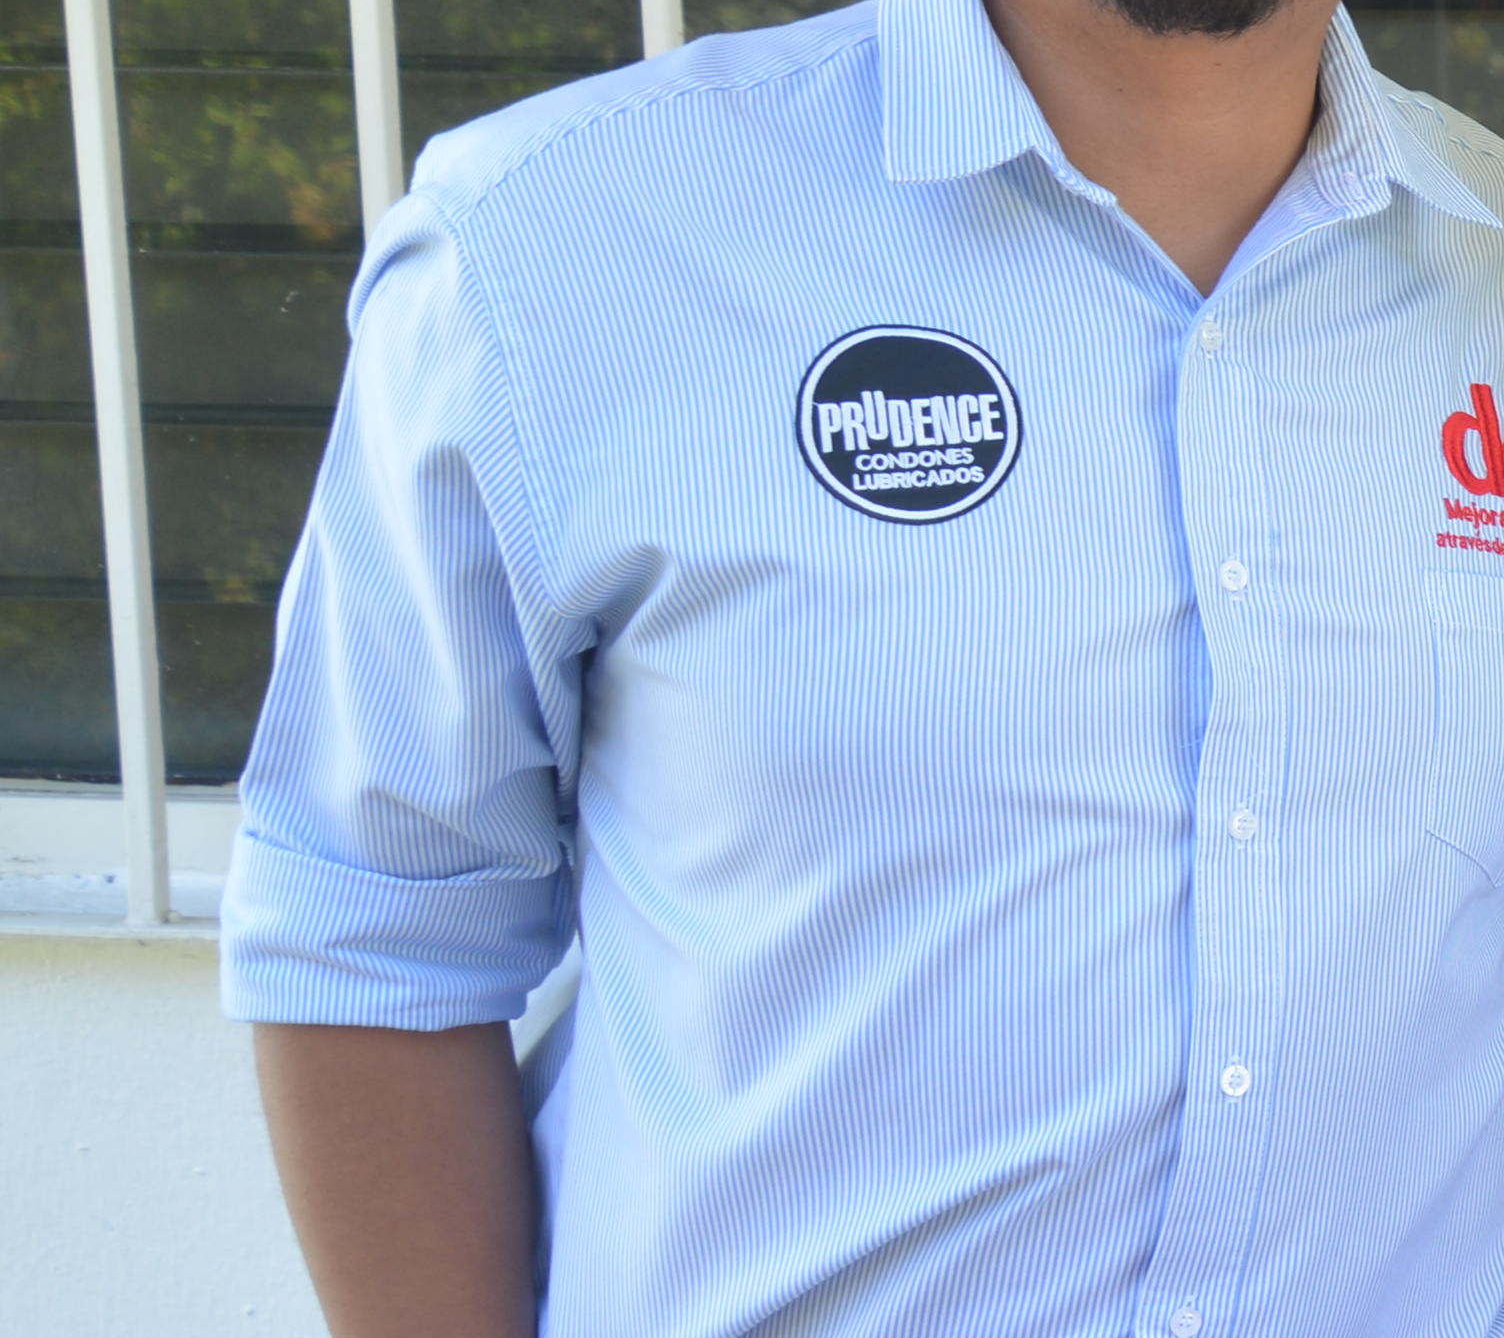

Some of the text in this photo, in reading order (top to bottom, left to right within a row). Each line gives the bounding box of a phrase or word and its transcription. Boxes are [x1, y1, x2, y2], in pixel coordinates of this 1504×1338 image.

[817, 390, 1004, 453] PRUDENCE
[855, 447, 974, 471] CONDONES
[852, 466, 985, 490] LUBRICADOS
